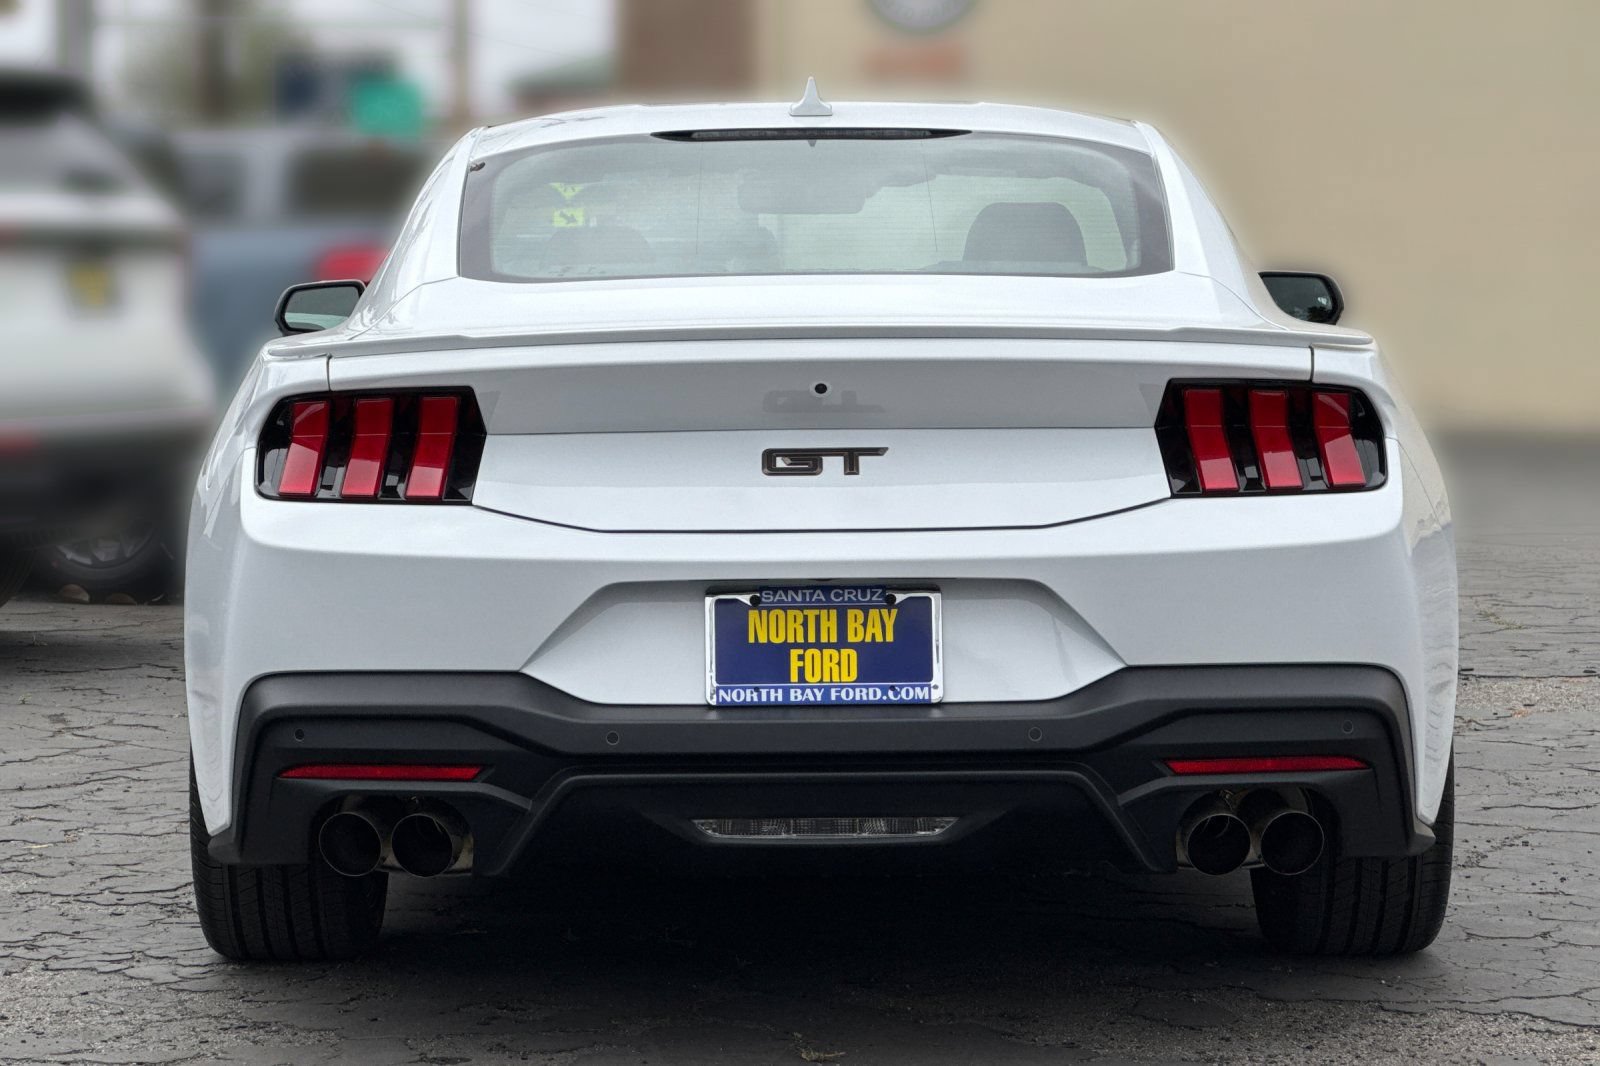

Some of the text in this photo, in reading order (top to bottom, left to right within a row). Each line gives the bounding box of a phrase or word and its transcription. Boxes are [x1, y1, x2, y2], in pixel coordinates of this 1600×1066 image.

[762, 447, 889, 476] GT
[761, 588, 884, 603] SANTA CRUZ
[748, 608, 898, 644] NORTH BAY
[790, 648, 858, 683] FORD
[718, 686, 930, 703] NORTH BAY FORD.COM
